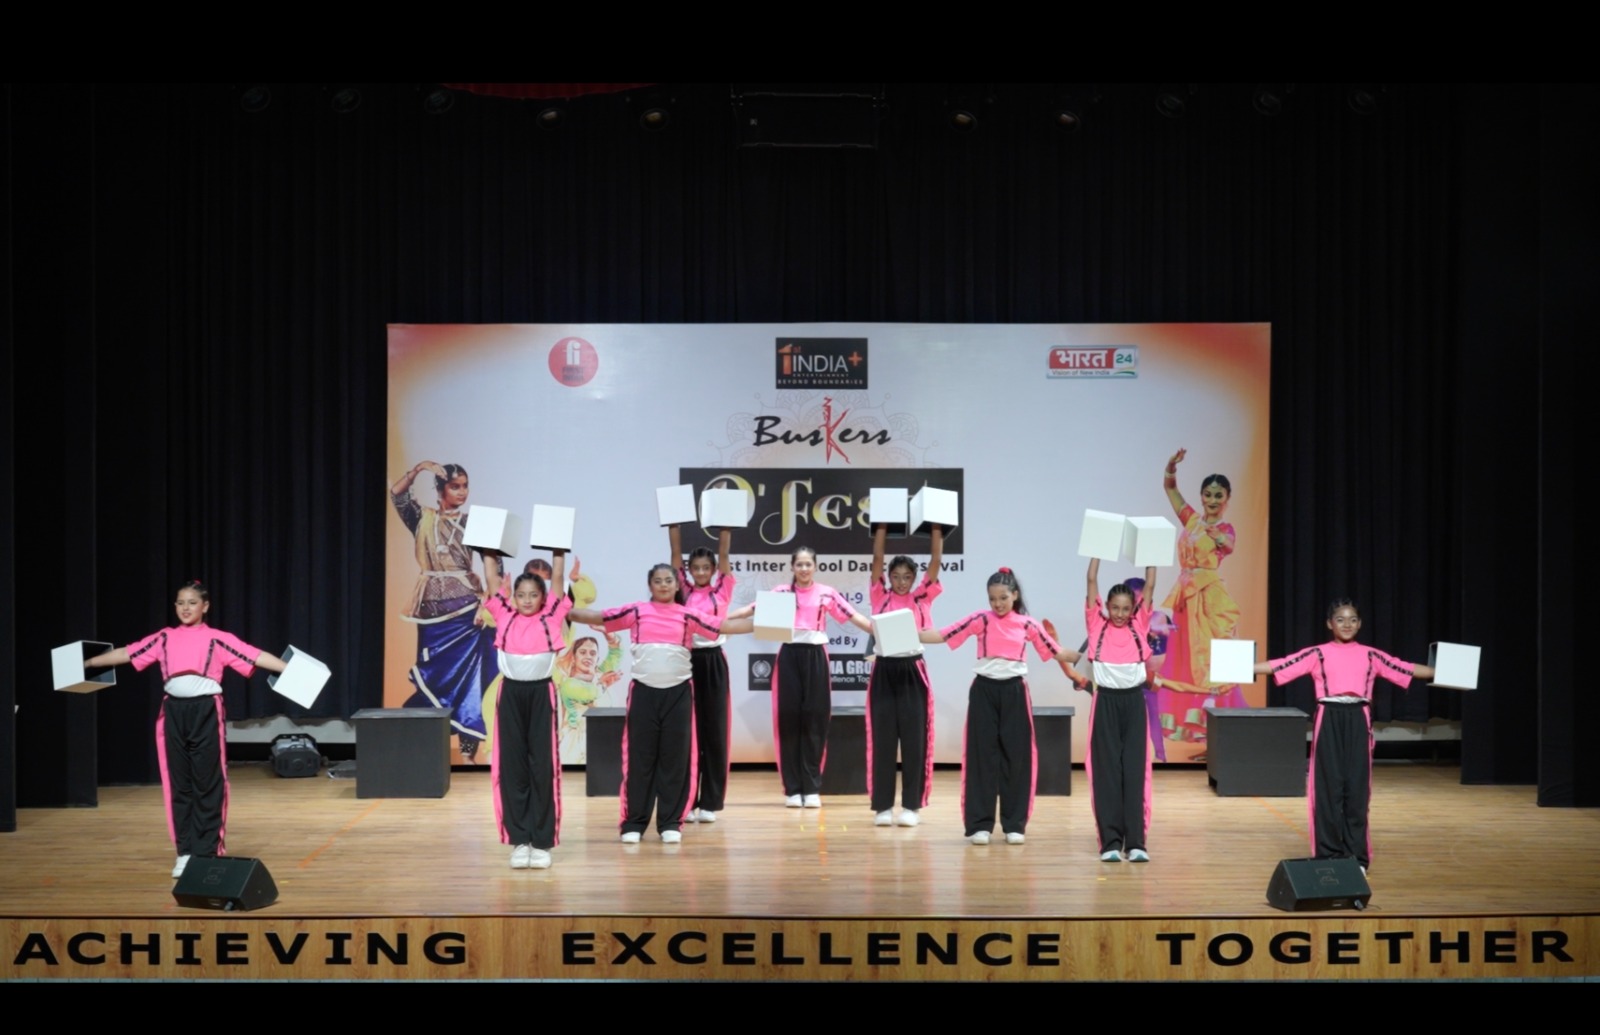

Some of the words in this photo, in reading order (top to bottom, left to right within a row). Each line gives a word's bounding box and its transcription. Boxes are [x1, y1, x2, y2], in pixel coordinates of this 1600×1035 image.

[1056, 350, 1108, 367] भारत
[1115, 353, 1132, 364] 24
[746, 559, 786, 572] Inter
[844, 636, 858, 647] By
[14, 932, 467, 966] ACHIEVING
[562, 932, 1060, 966] EXCELLENCE
[1157, 931, 1574, 967] TOGETHER
